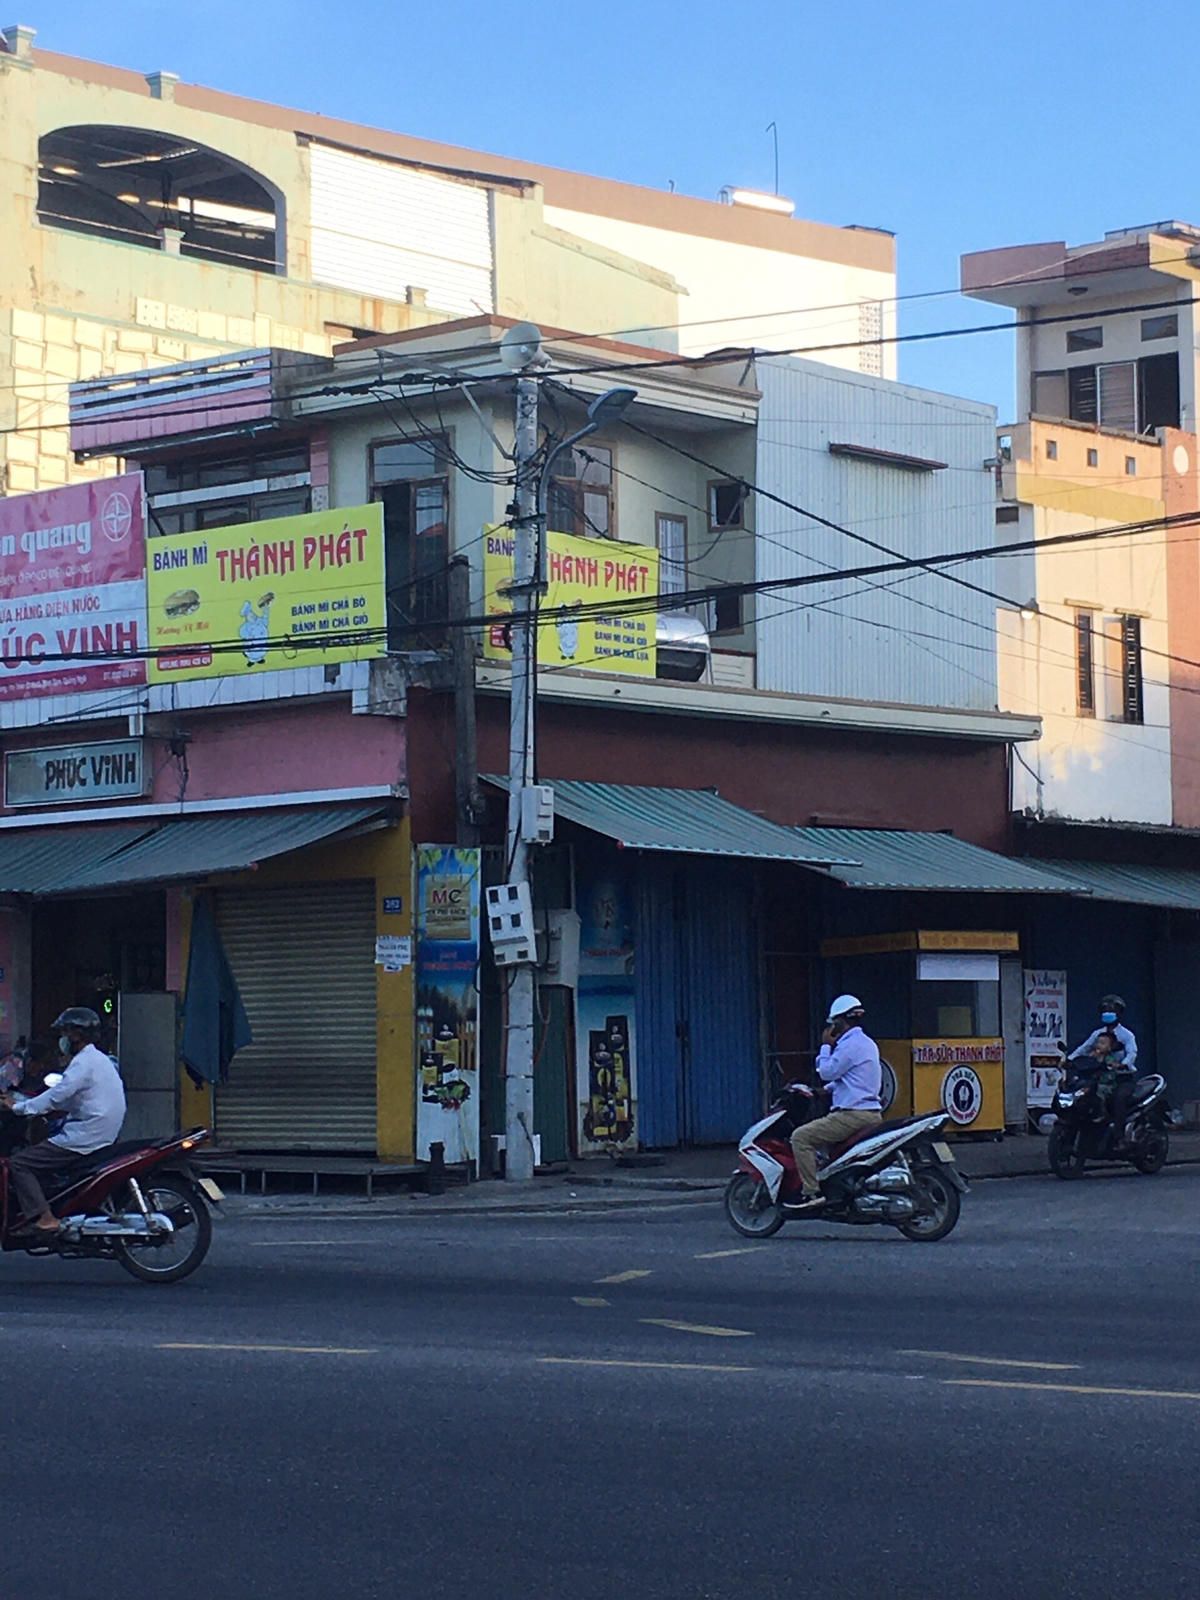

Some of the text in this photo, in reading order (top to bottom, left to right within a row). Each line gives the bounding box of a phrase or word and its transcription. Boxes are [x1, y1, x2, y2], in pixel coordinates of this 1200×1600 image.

[21, 521, 91, 563] quang
[153, 523, 367, 582] BÁNH MÌ THÀNH PHÁT
[547, 547, 598, 588] HÀNH
[604, 558, 649, 593] PHÁT
[56, 620, 137, 660] VINH
